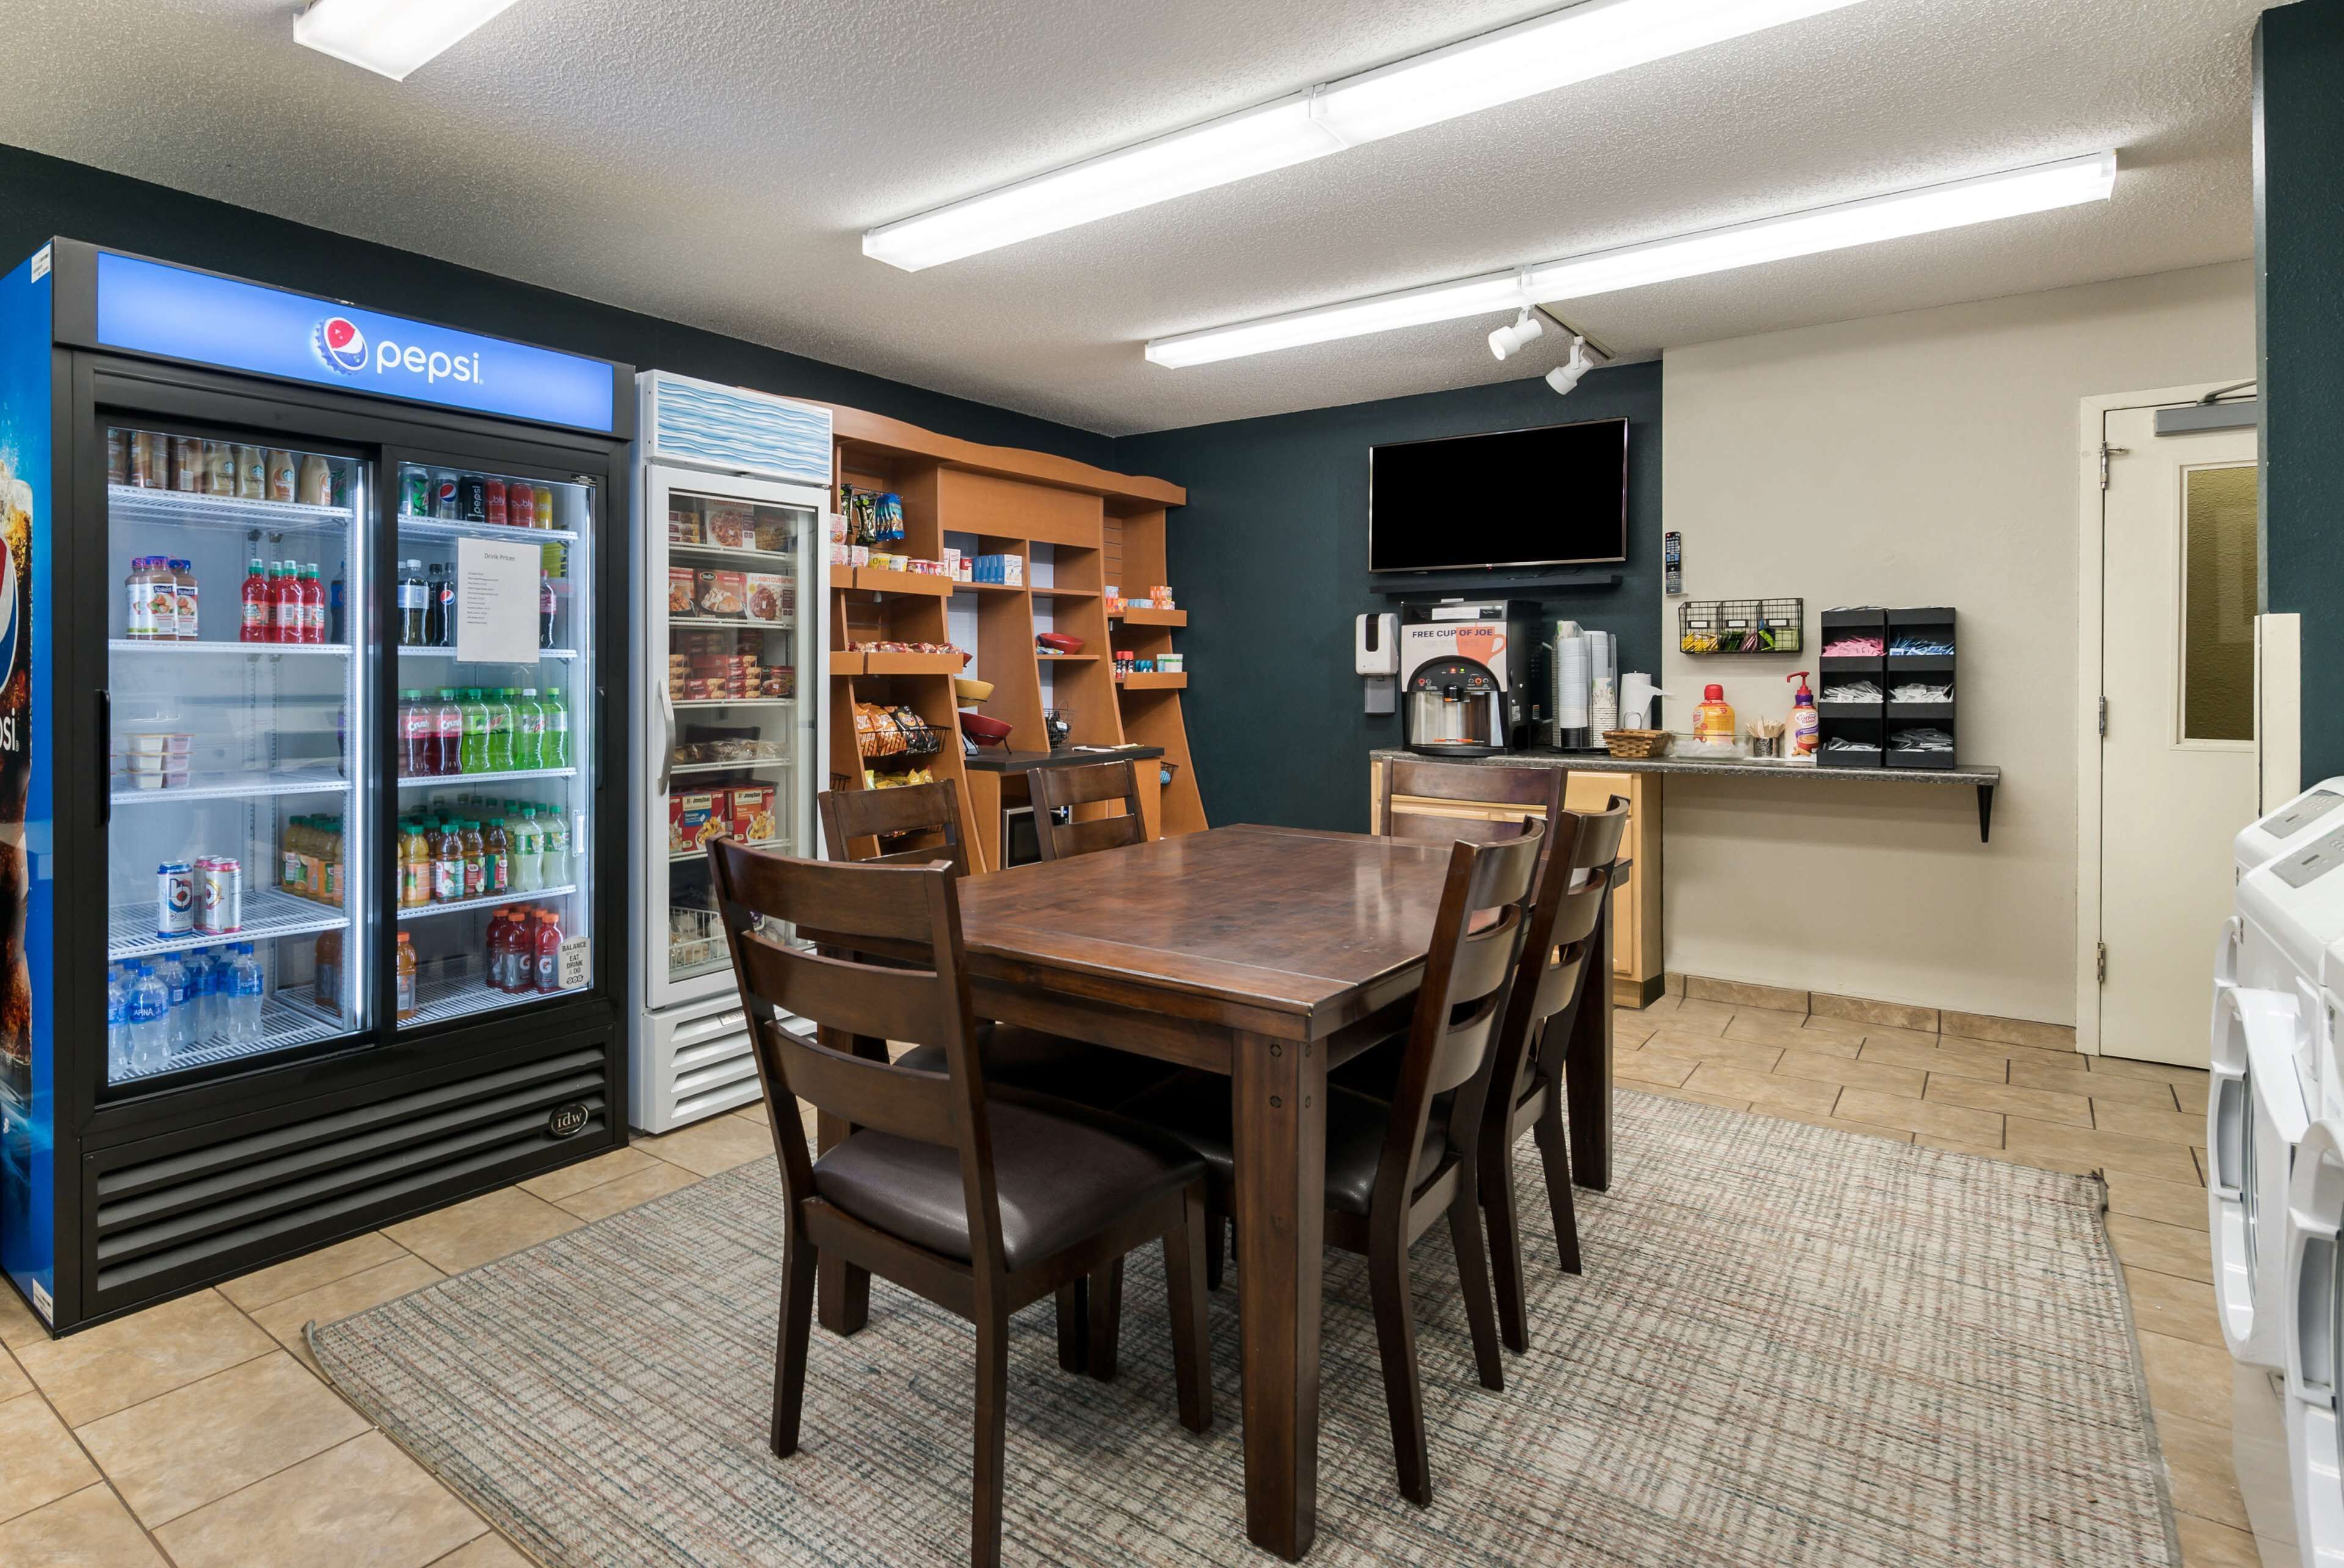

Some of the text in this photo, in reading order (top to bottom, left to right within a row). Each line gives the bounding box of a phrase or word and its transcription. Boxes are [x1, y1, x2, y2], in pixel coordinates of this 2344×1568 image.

[376, 341, 480, 384] pepsi
[473, 485, 482, 514] pepsi
[562, 941, 587, 952] BALANCE
[566, 960, 582, 970] DRINK
[573, 967, 581, 975] DO
[557, 1111, 582, 1128] idw
